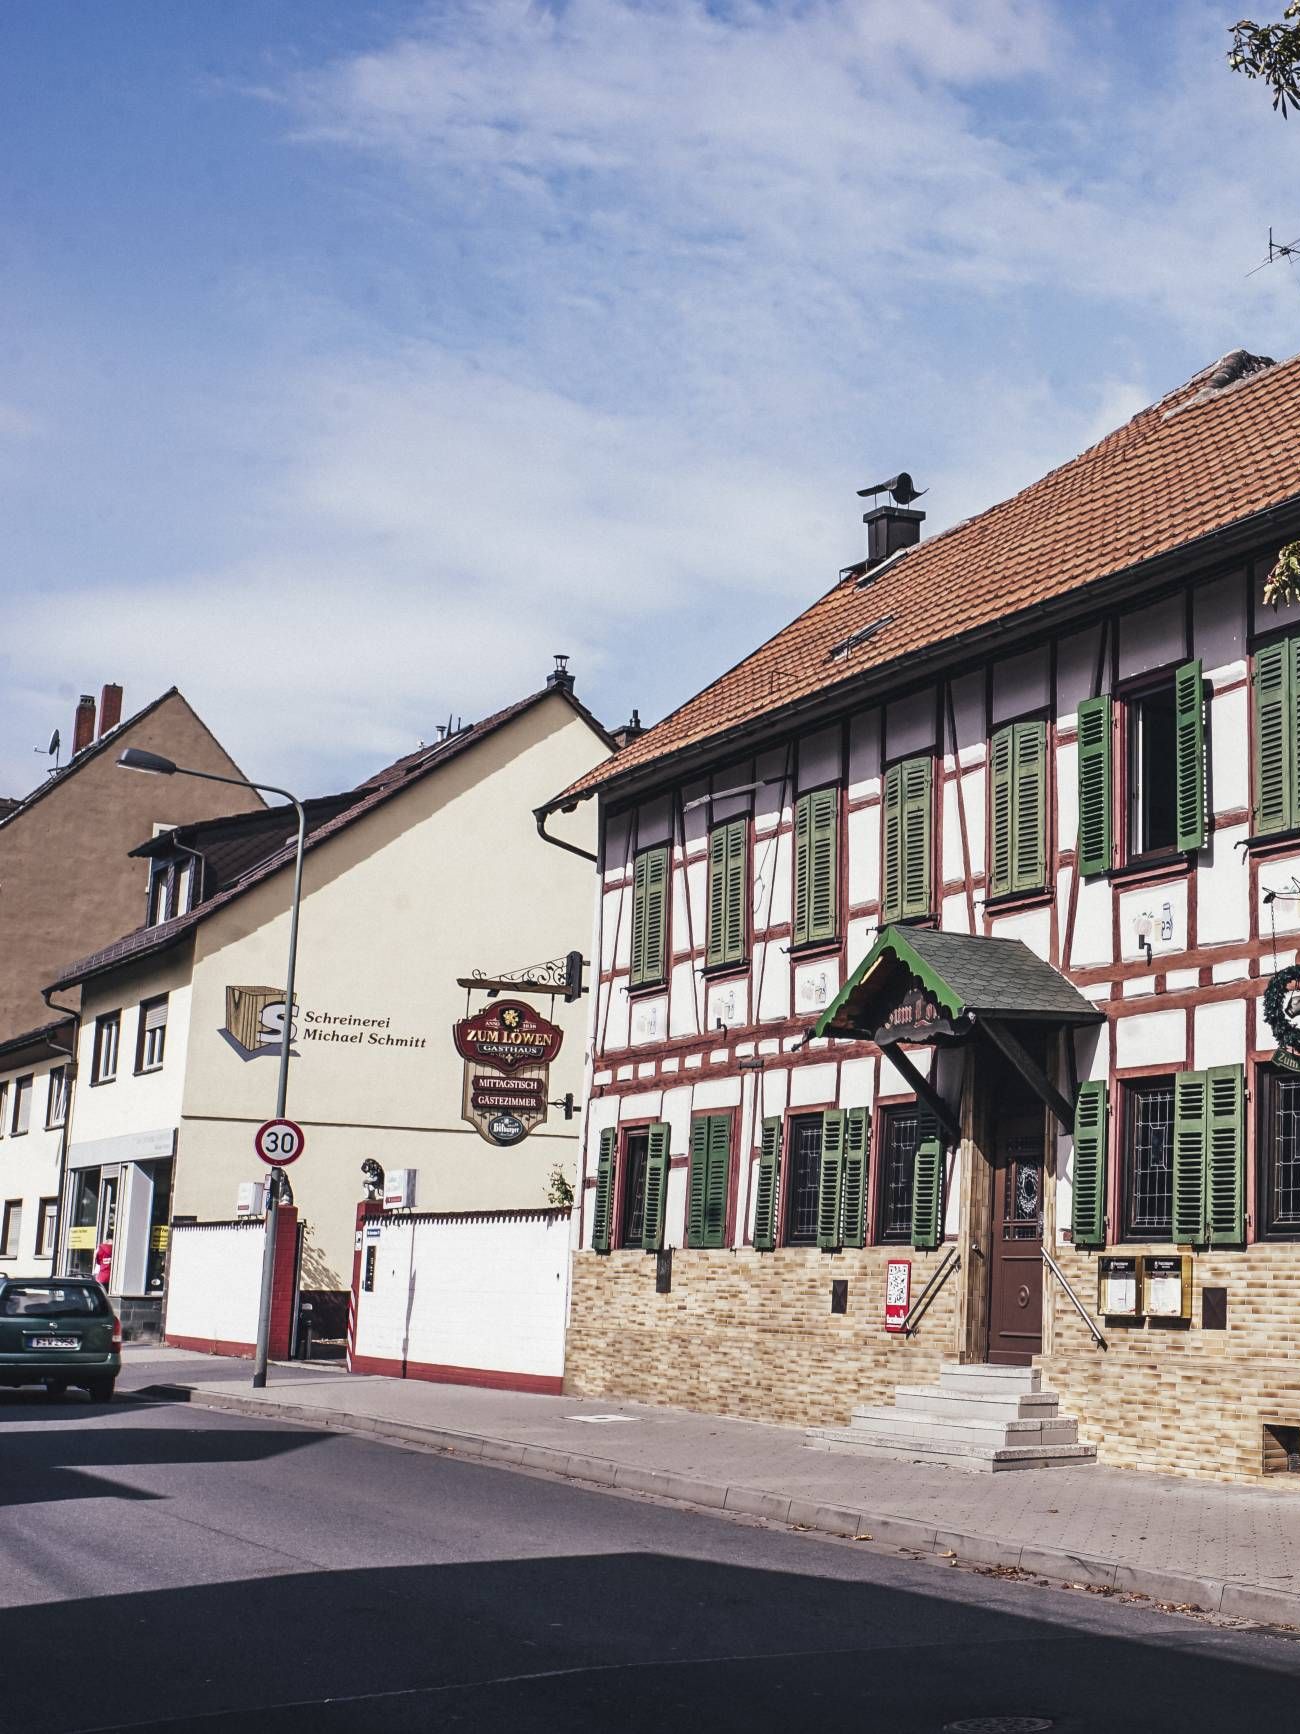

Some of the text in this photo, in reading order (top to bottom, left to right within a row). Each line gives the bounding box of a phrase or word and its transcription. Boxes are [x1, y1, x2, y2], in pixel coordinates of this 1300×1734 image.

[304, 1010, 391, 1029] Schreinerei
[303, 1028, 427, 1048] Michael Schmitt
[466, 1029, 553, 1046] ZUM LÖWEN
[483, 1045, 537, 1053] GASTHAUS
[1278, 1052, 1298, 1069] Zum
[479, 1078, 538, 1090] MITTAGSTISCH
[478, 1095, 537, 1107] GÄSTEZIMMER
[265, 1131, 295, 1154] 30
